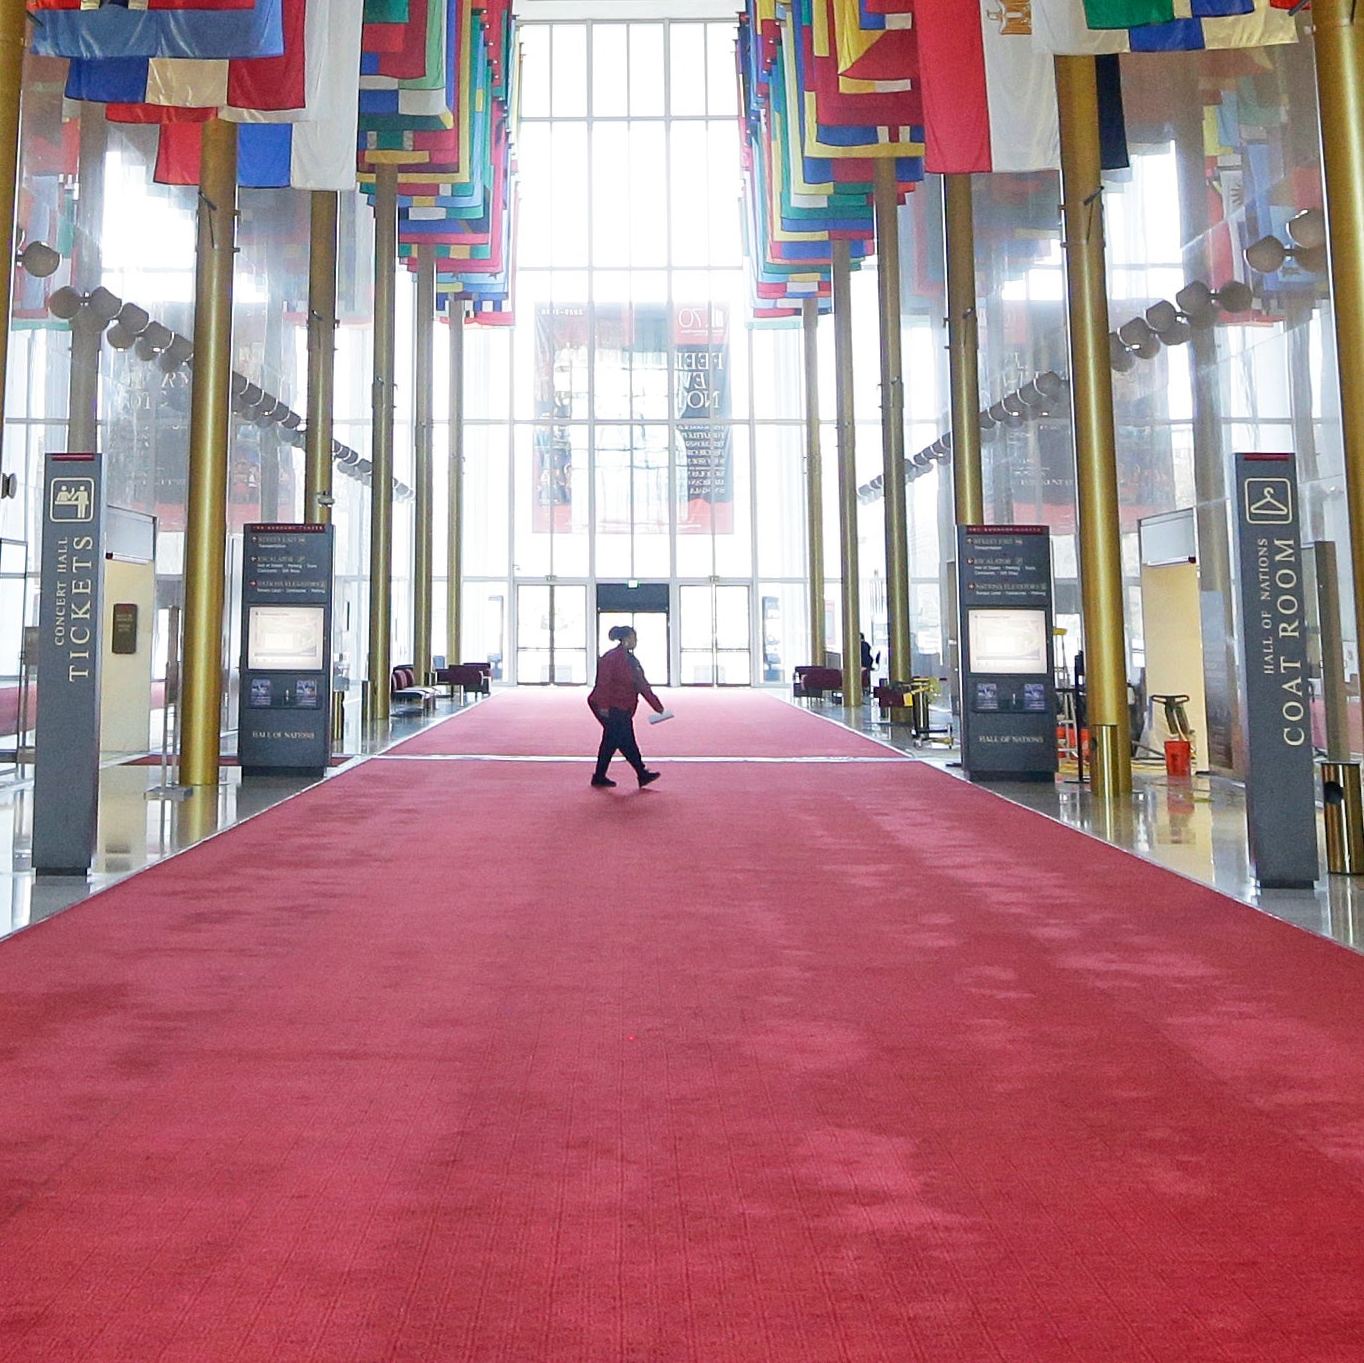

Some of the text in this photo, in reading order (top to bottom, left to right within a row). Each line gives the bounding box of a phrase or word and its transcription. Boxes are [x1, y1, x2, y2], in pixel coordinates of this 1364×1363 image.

[54, 538, 68, 646] CONCERT HALL
[68, 536, 93, 682] TICKETS
[1257, 538, 1274, 674] HALL OF NATIONS
[1274, 538, 1305, 746] COAT ROOM
[979, 735, 998, 743] HALL
